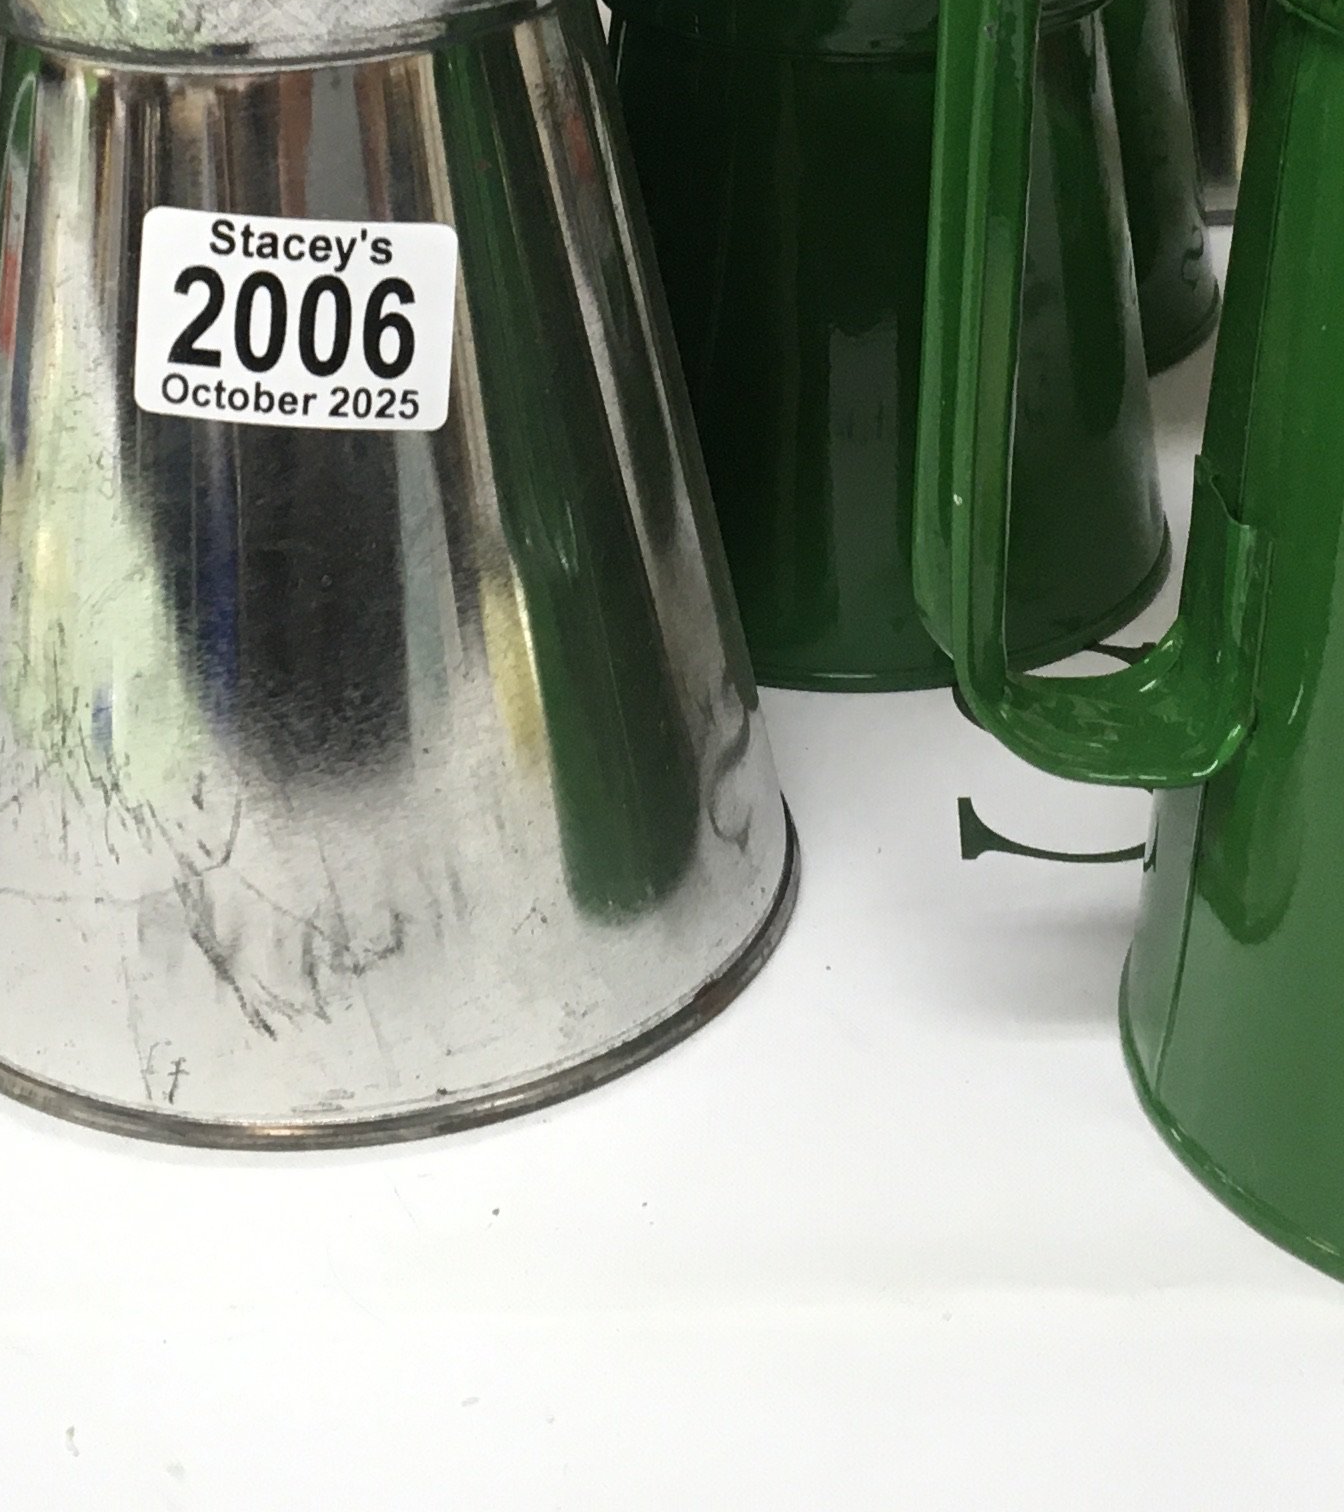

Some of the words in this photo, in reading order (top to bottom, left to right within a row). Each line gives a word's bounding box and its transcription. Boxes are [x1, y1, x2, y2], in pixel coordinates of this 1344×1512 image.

[209, 219, 394, 272] Stacey's
[167, 264, 416, 379] 2006
[161, 372, 317, 416] October
[328, 386, 420, 420] 2025
